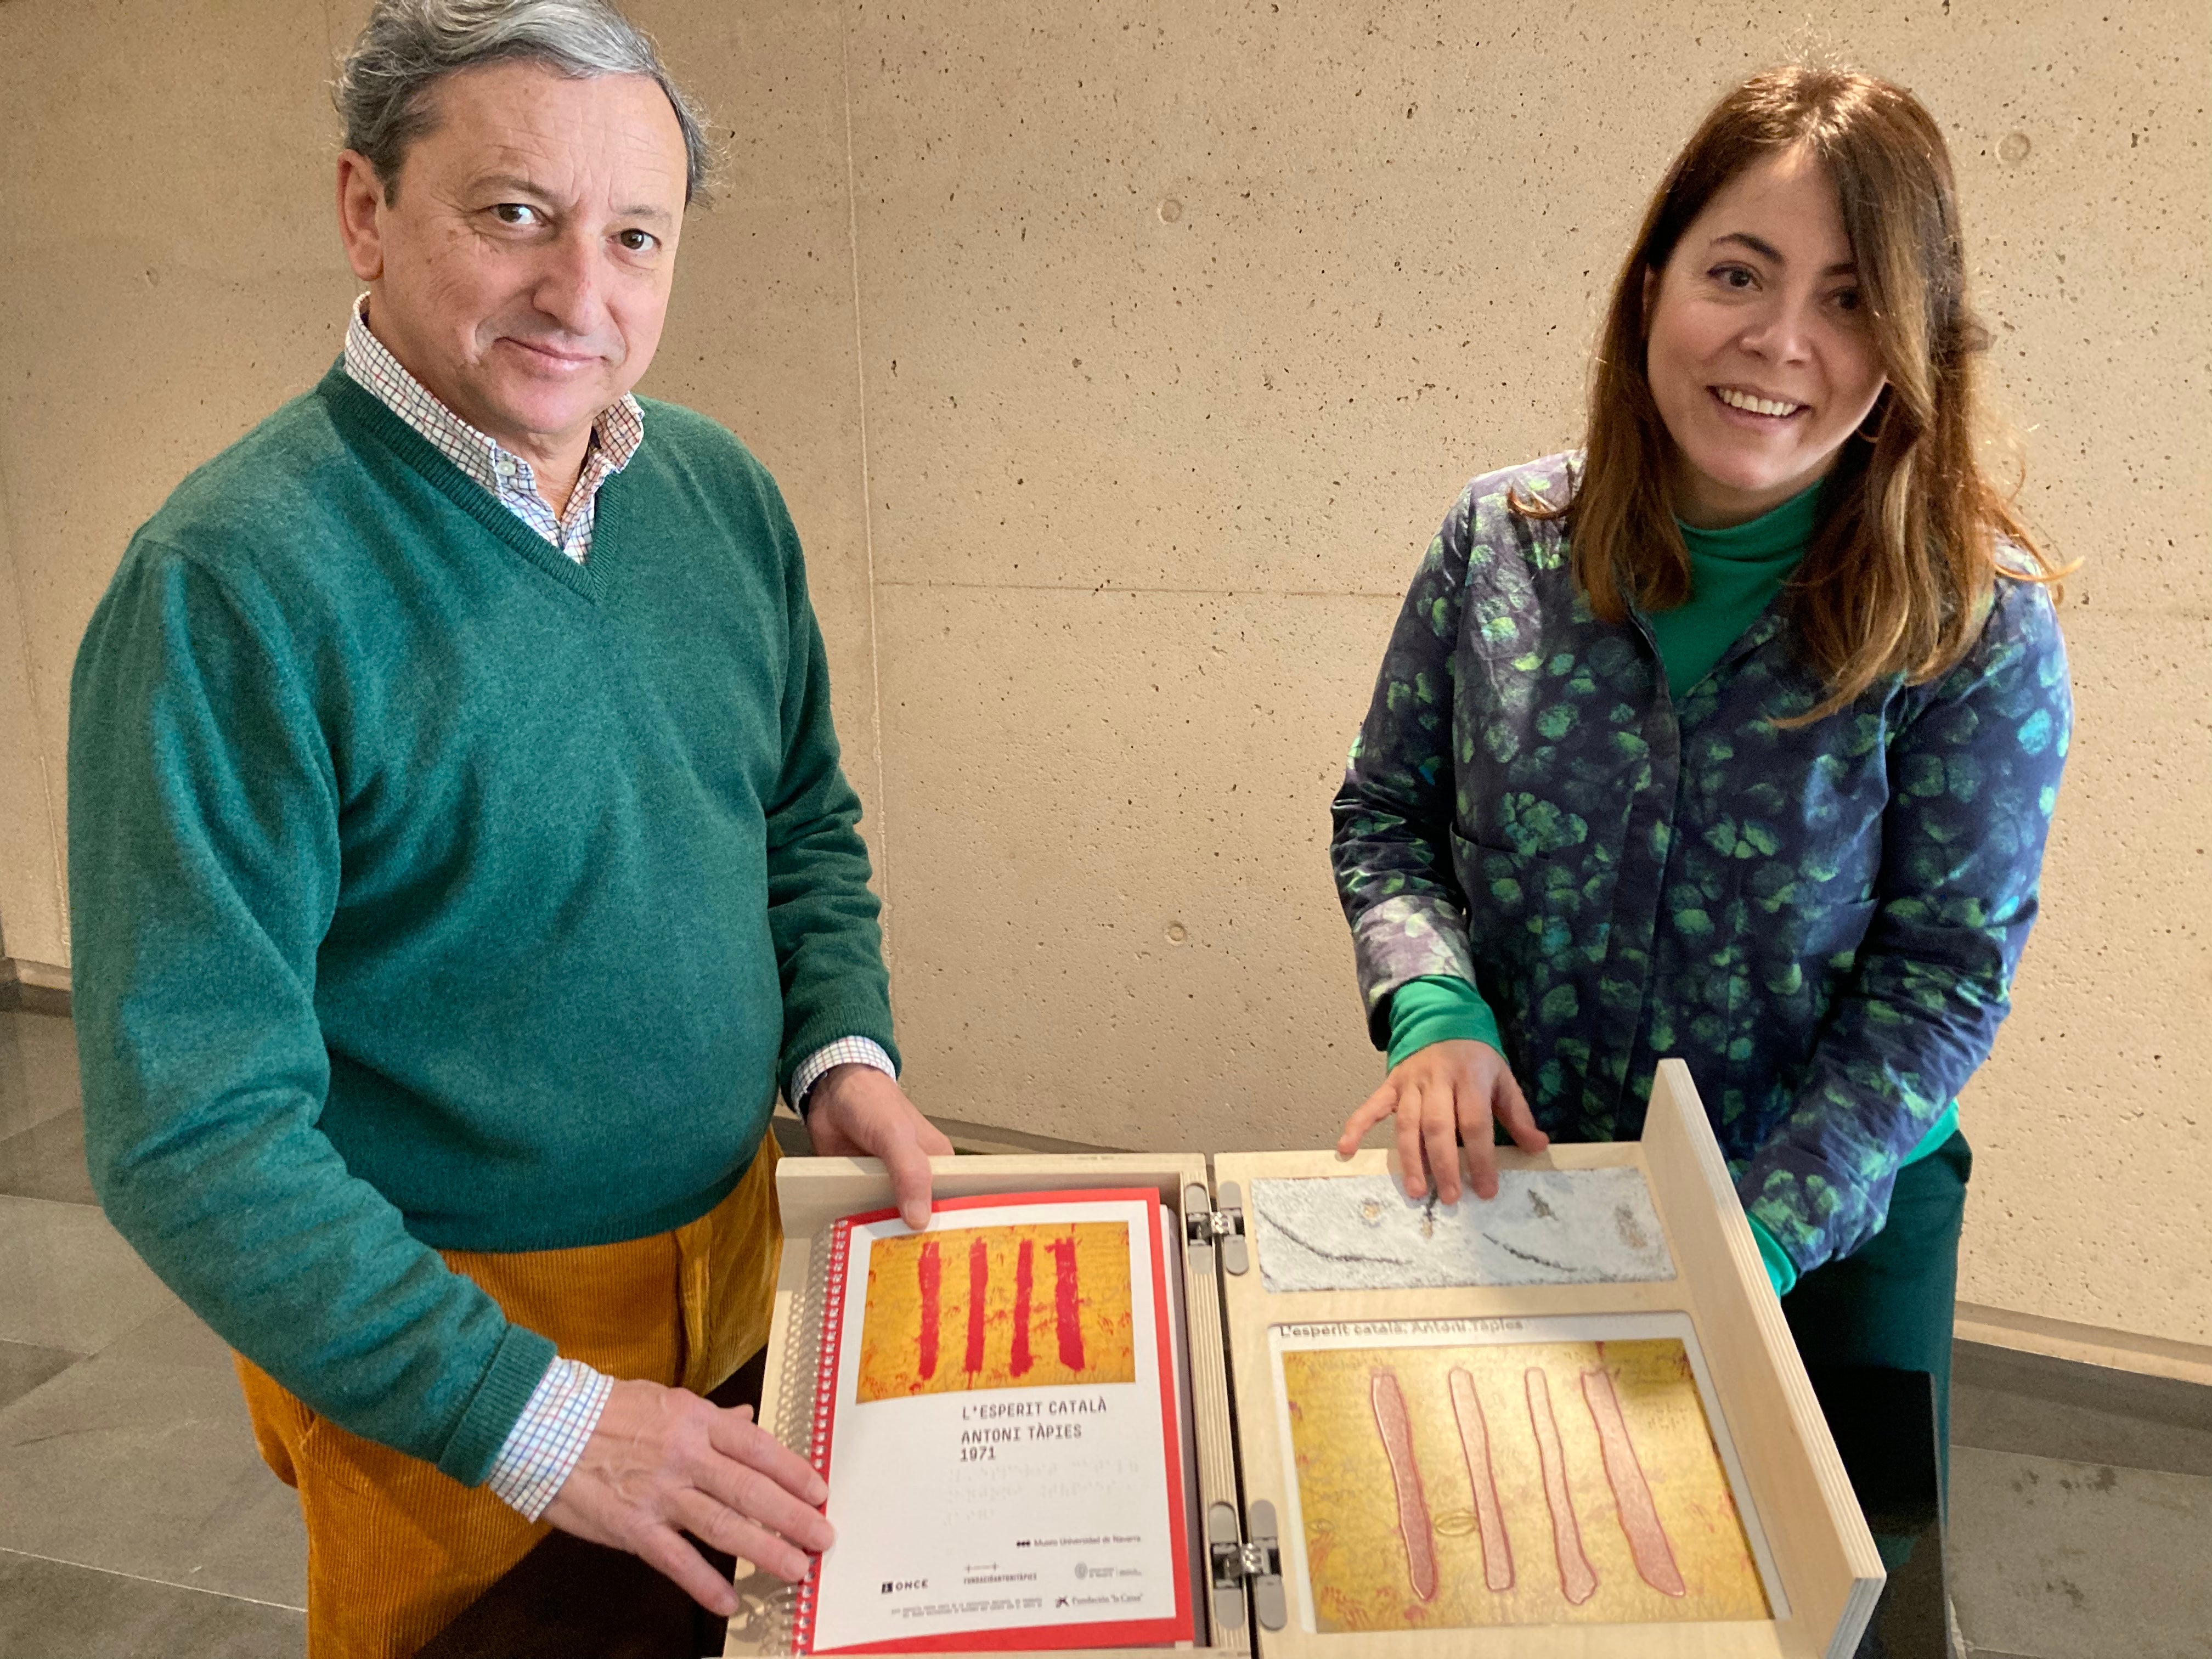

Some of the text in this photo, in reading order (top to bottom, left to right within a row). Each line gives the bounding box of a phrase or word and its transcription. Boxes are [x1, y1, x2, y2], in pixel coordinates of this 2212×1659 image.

[962, 1396, 1107, 1420] L'ESPERIT CATALÀ
[961, 1423, 1082, 1444] ANTONI TÀPIES
[960, 1446, 996, 1462] 1971
[895, 1578, 929, 1591] ONCE
